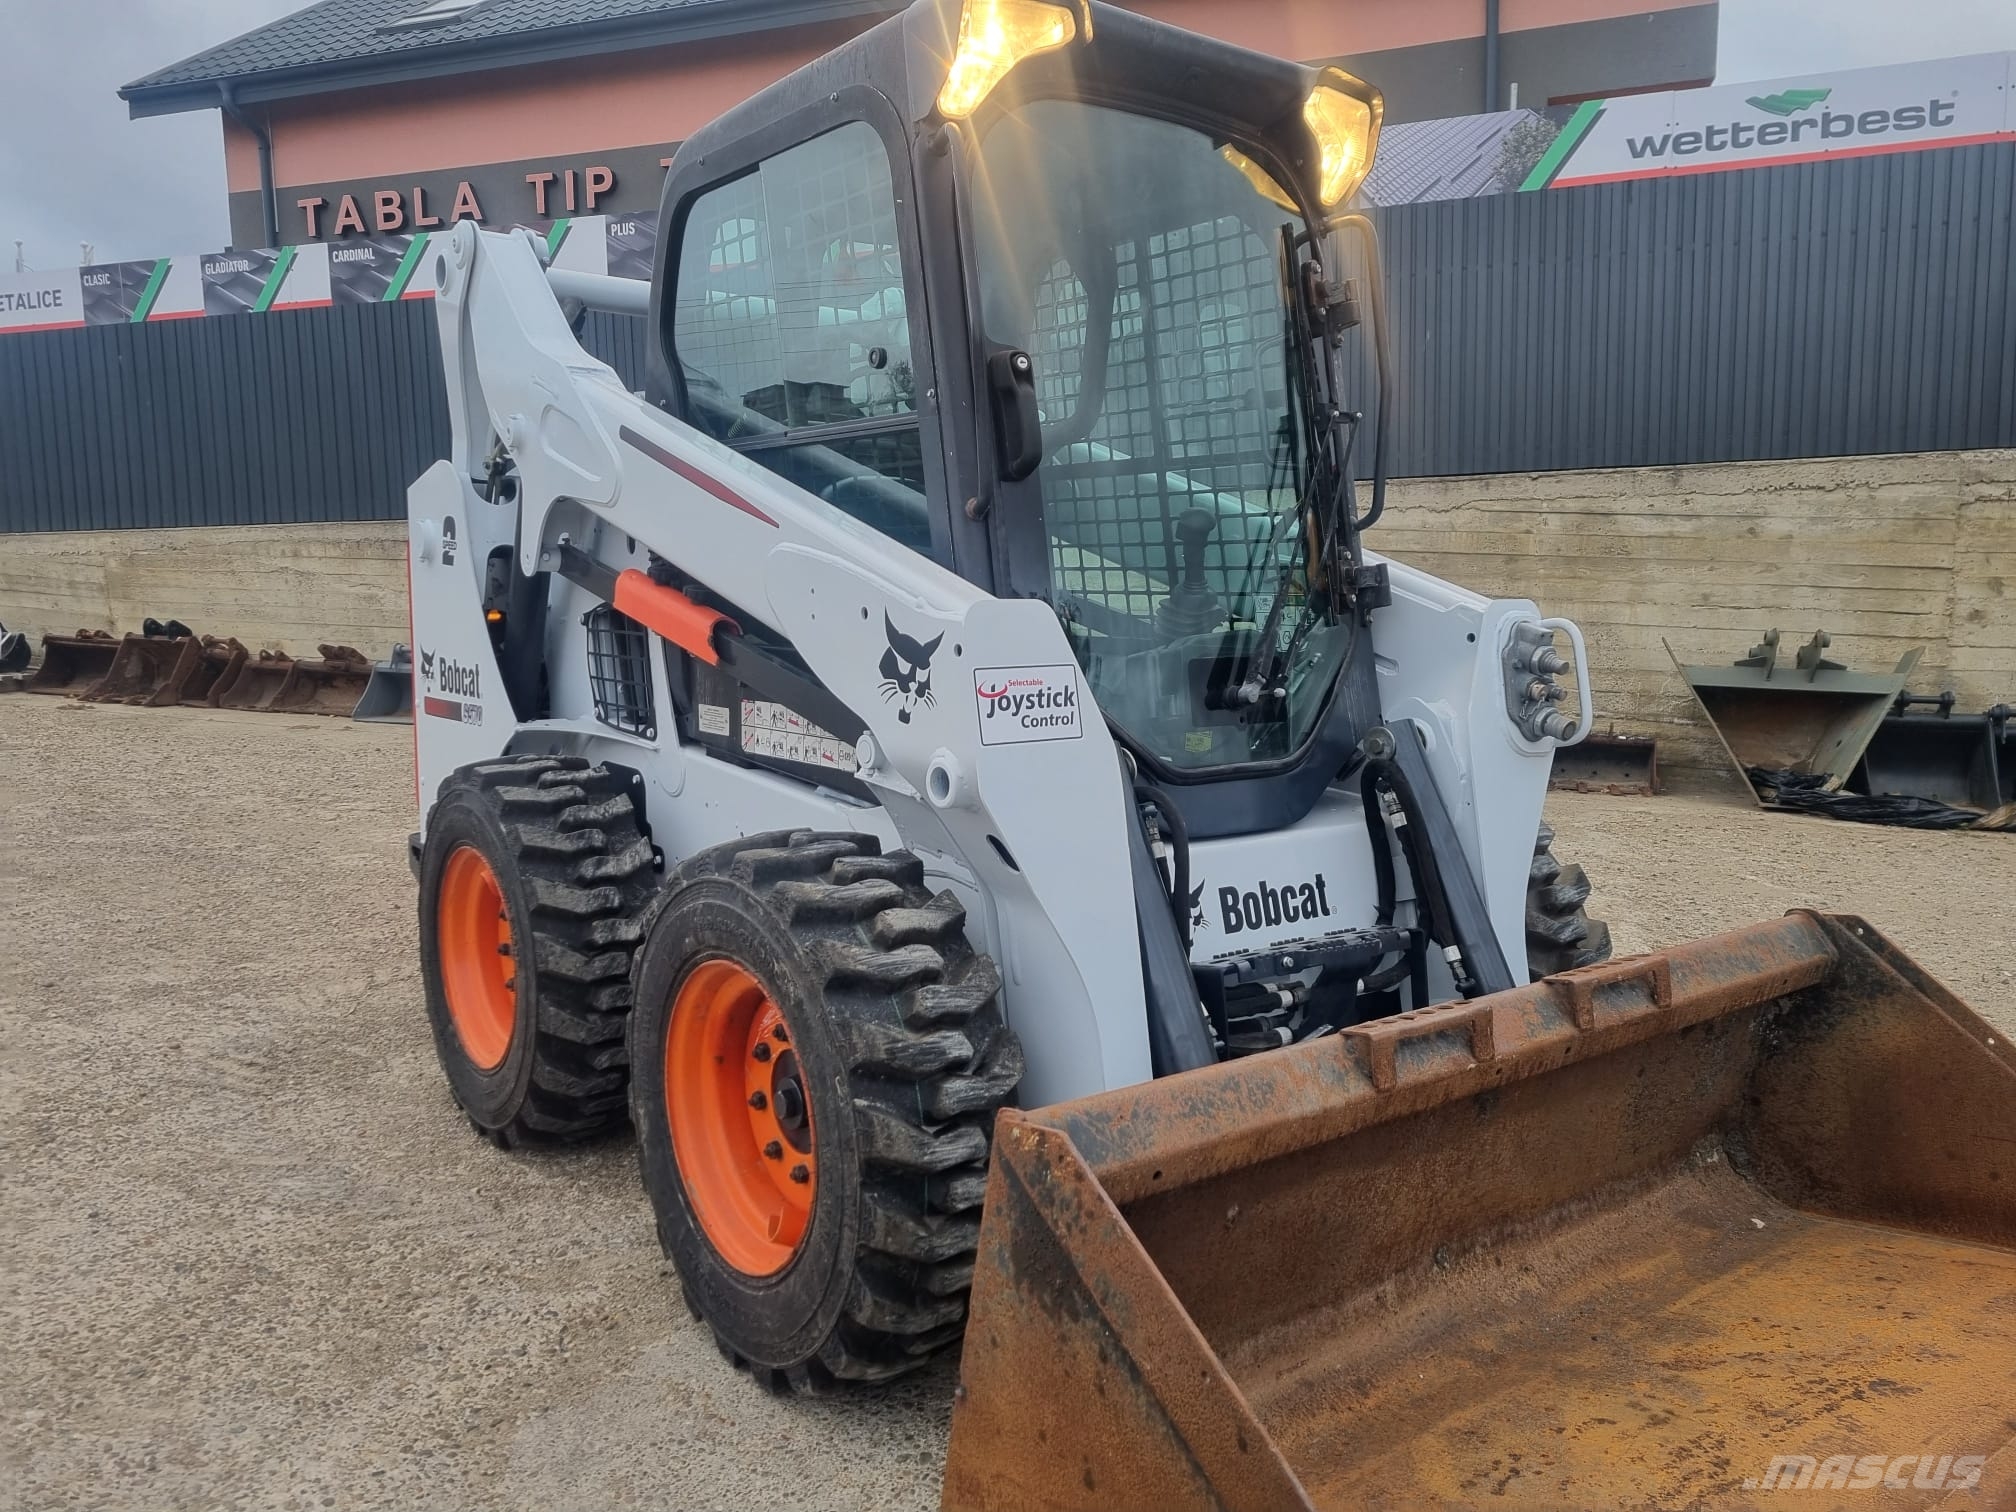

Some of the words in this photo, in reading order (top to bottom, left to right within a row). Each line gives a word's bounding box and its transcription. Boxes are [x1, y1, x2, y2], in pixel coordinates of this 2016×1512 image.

[1626, 99, 1957, 159] wetterbest
[297, 181, 483, 238] TABLA
[526, 166, 614, 214] TIP
[611, 222, 636, 237] PLUS
[332, 247, 375, 263] CARDINAL
[205, 259, 249, 275] GLADIATOR
[83, 273, 111, 287] CLASIC
[439, 656, 480, 699] Bobcat
[1008, 678, 1044, 687] Selectable
[986, 683, 1075, 719] Joystick
[1021, 711, 1075, 728] Control
[1218, 873, 1331, 935] Bobcat
